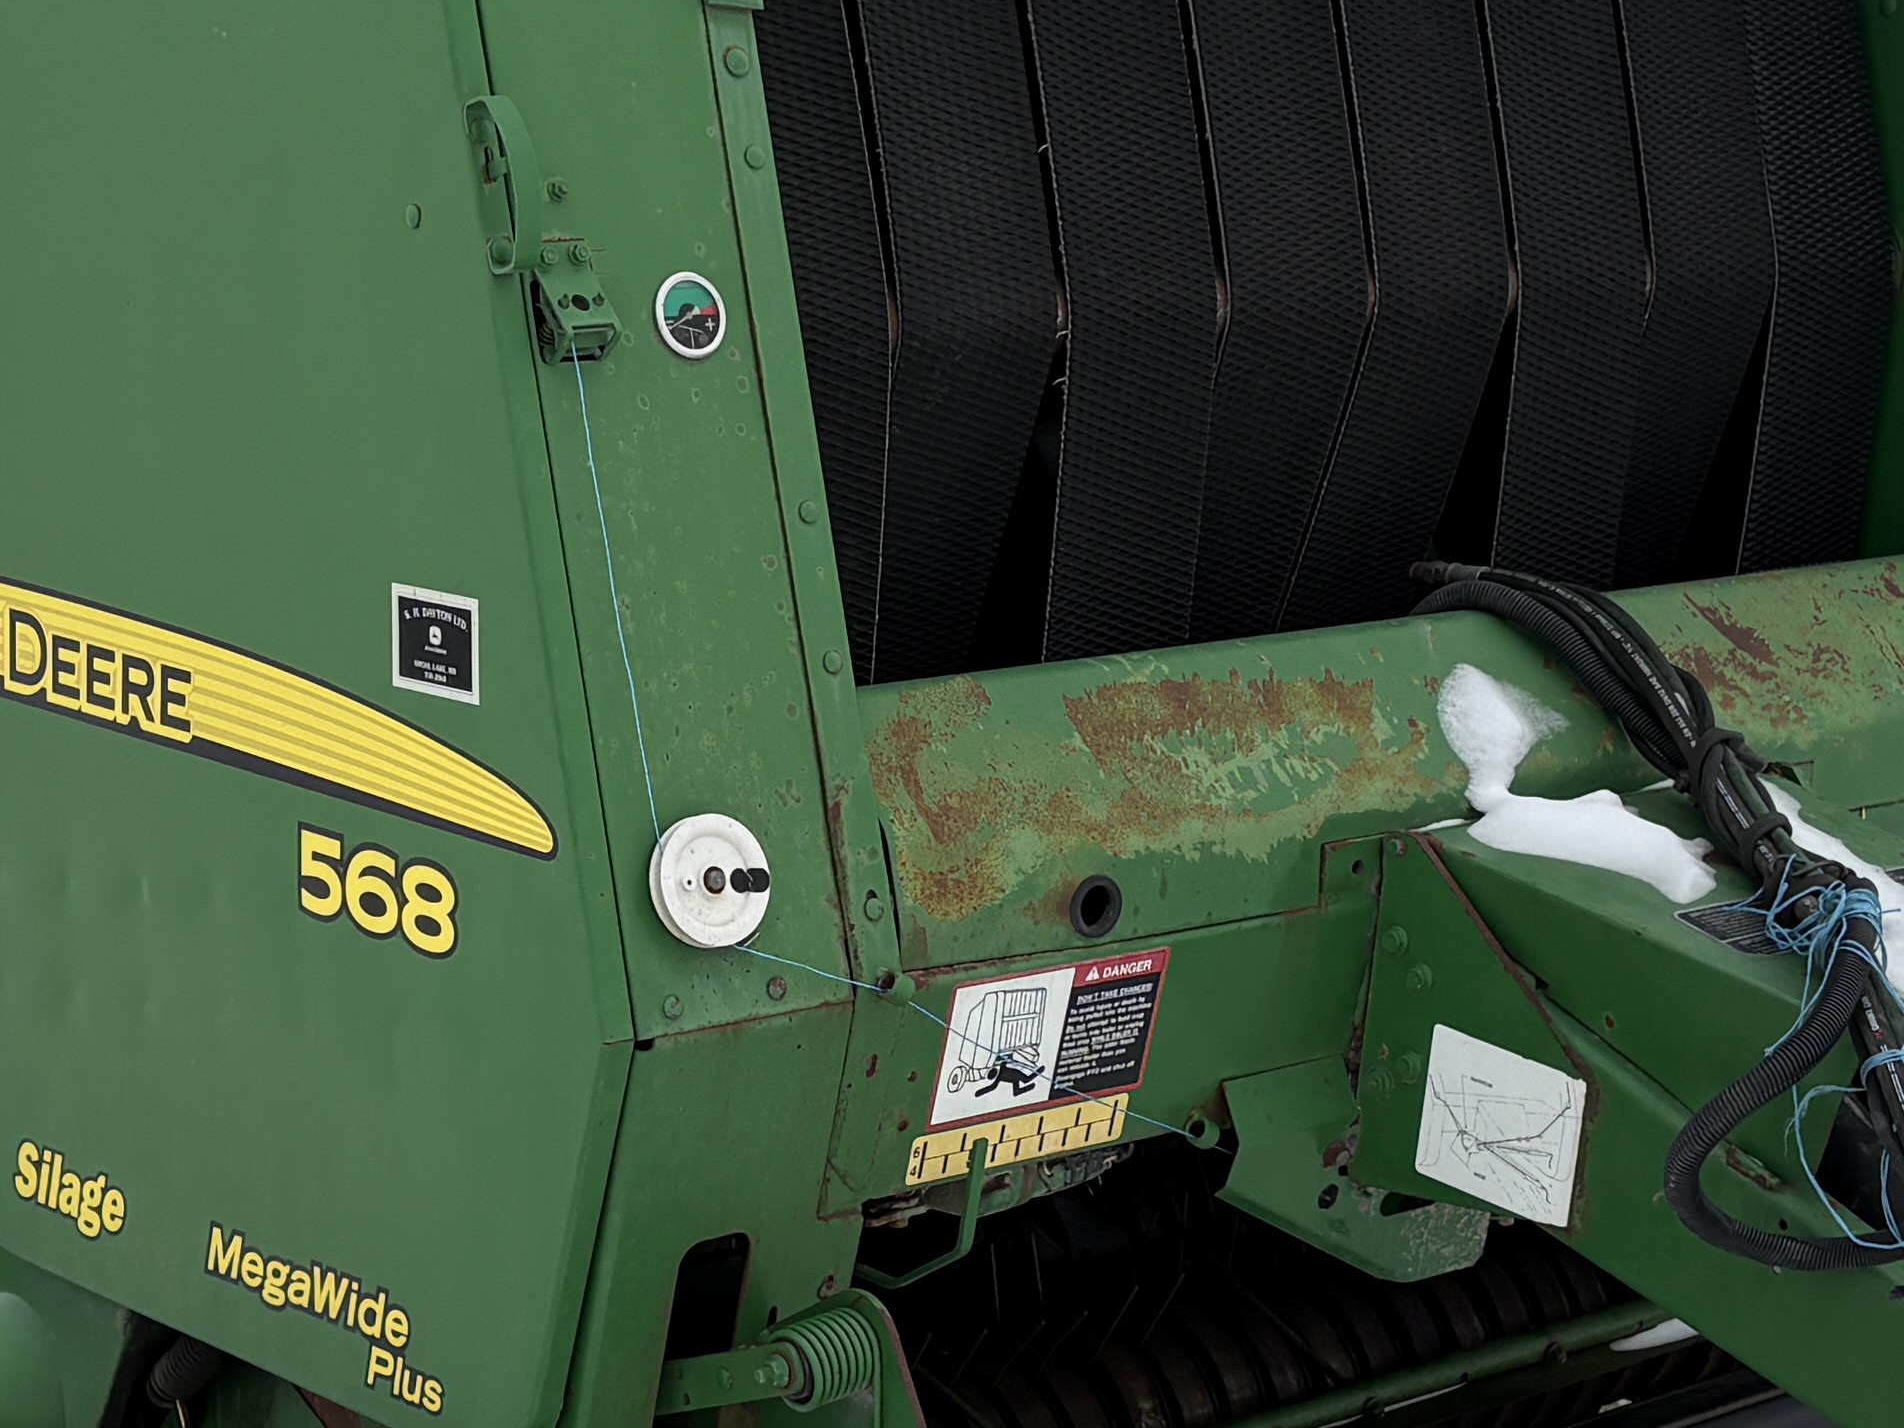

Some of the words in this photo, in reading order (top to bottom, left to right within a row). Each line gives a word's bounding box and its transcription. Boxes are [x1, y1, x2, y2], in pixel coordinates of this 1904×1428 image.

[7, 607, 194, 736] DEERE
[299, 825, 458, 957] 568
[1102, 959, 1153, 978] DANGER
[14, 1140, 126, 1239] Silage
[909, 1165, 917, 1177] 4
[913, 1146, 921, 1159] 6
[205, 1225, 411, 1349] MegaWide
[366, 1344, 444, 1413] Plus
